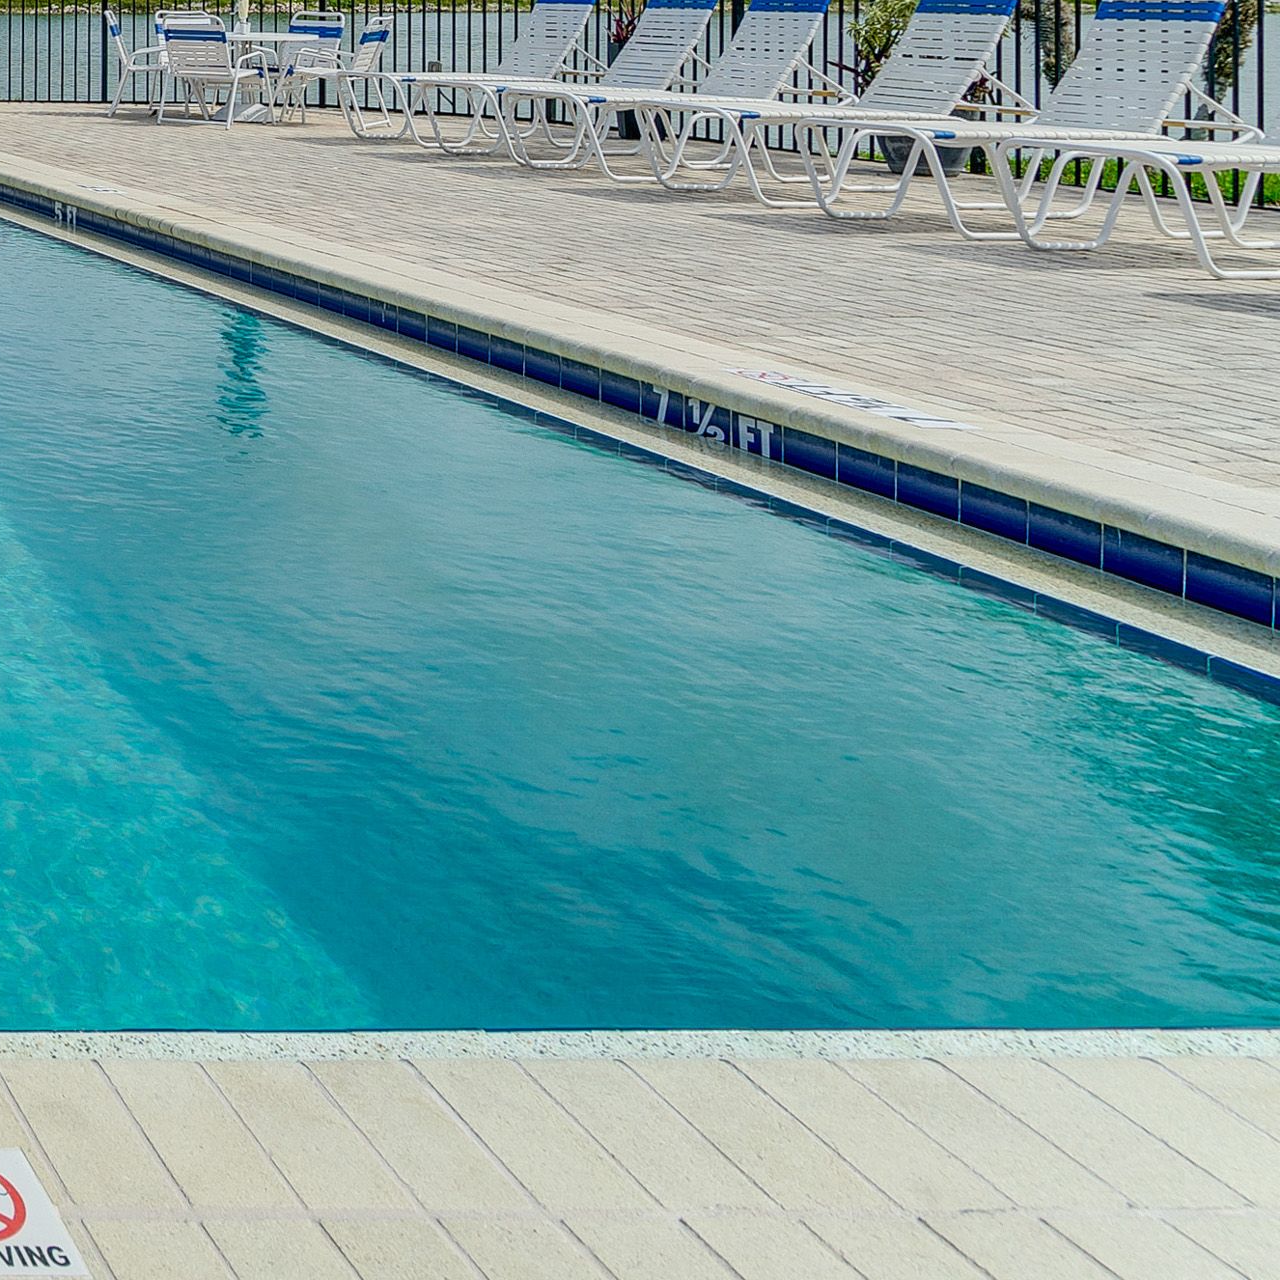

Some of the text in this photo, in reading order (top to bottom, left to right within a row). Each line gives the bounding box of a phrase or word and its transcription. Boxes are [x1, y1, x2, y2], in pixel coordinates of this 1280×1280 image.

[55, 201, 77, 225] 5 FT
[653, 386, 670, 424] 7
[740, 415, 774, 458] FT
